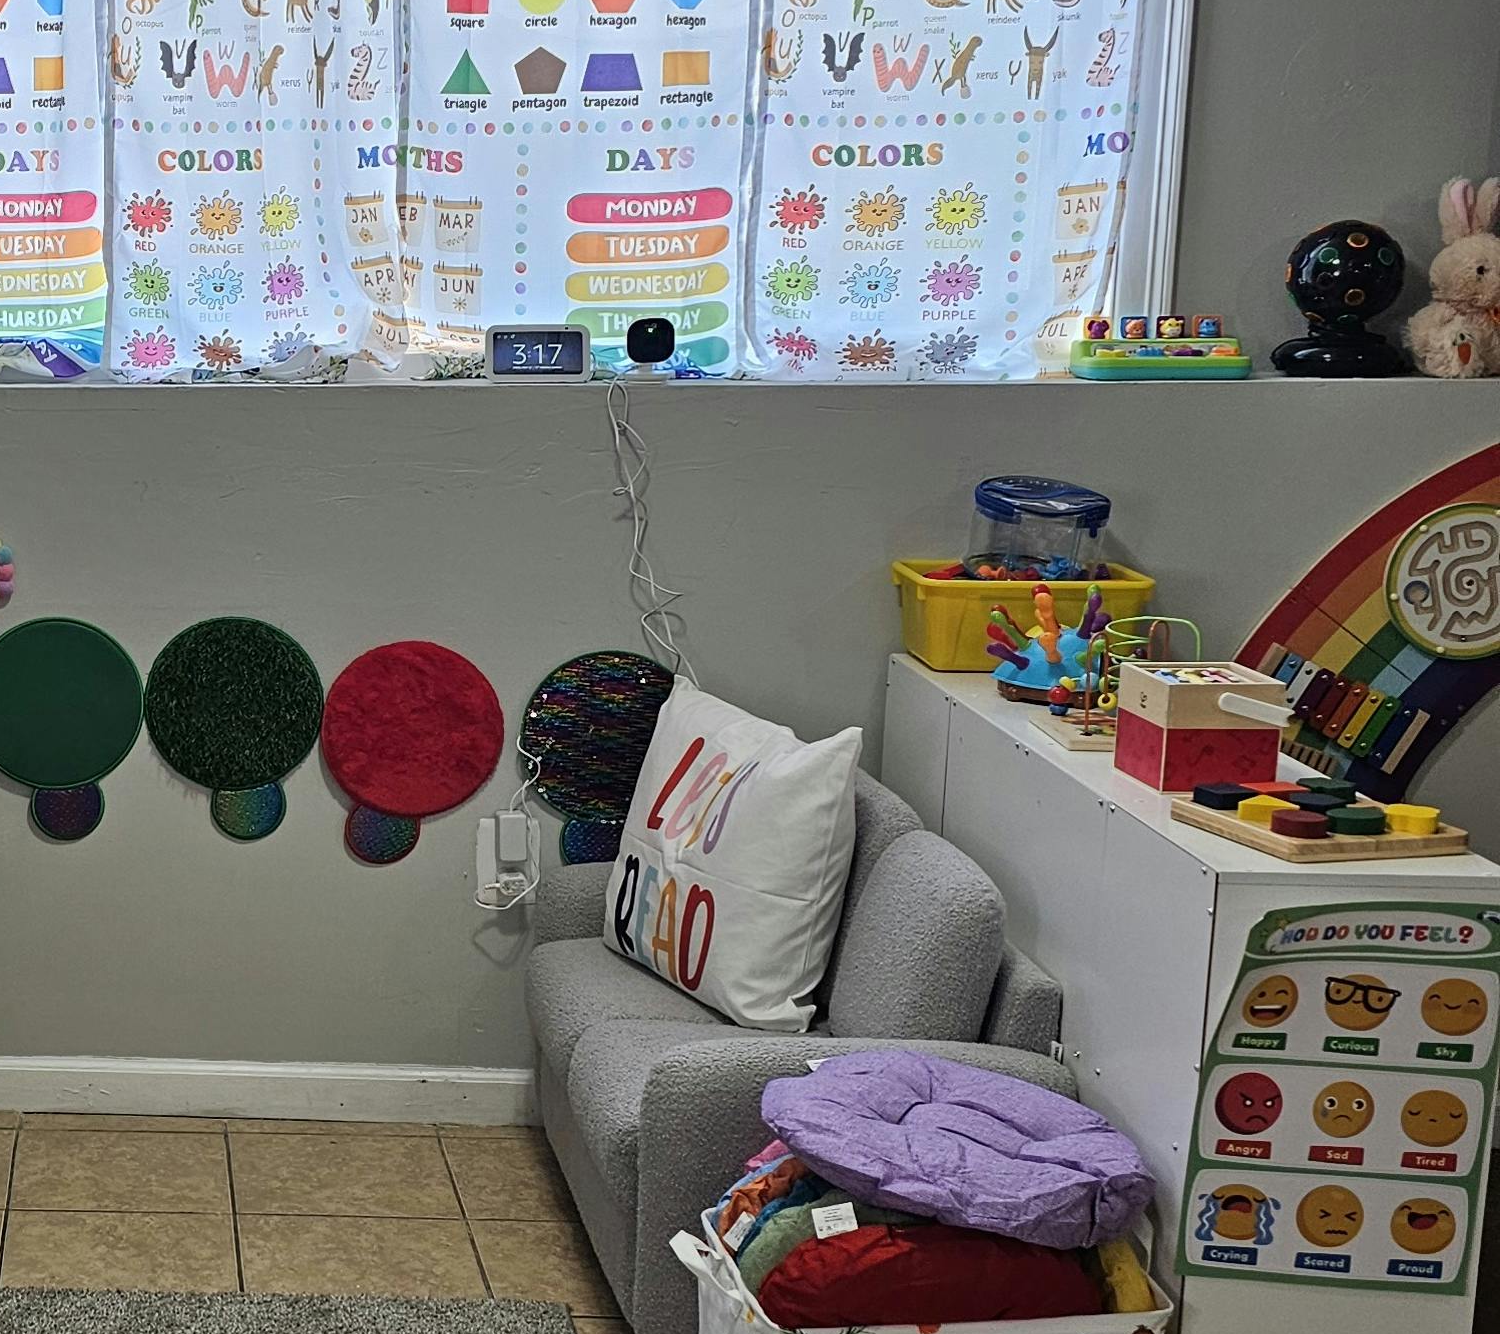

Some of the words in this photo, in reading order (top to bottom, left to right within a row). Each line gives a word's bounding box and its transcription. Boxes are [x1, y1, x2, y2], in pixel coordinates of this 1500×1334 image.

[449, 17, 485, 30] square
[525, 15, 558, 28] circle
[589, 14, 638, 29] hexagon
[666, 14, 706, 30] hexagon
[444, 96, 488, 112] triangle
[512, 97, 568, 113] pentagon
[583, 95, 640, 111] trapezoid
[660, 90, 714, 106] rectangle
[157, 149, 264, 172] COLORS
[606, 145, 696, 172] DAYS
[812, 142, 944, 167] COLORS
[605, 195, 698, 220] MONDAY
[1062, 196, 1101, 215] JAN
[351, 207, 378, 224] JAN
[439, 213, 474, 229] MAR
[133, 240, 157, 253] RED
[188, 243, 245, 255] ORANGE
[606, 233, 700, 258] TUESDAY
[781, 237, 807, 249] RED
[842, 239, 905, 252] ORANGE
[924, 236, 984, 250] YELLOW
[363, 271, 395, 289] APR
[440, 277, 475, 295] JUN
[588, 269, 709, 295] WEDNESDAY
[128, 306, 170, 319] GREEN
[265, 306, 310, 321] PURPLE
[770, 305, 812, 321] GREEN
[850, 310, 885, 322] BLUE
[921, 309, 977, 321] PURPLE
[1037, 322, 1069, 339] JUL
[512, 343, 564, 365] 3:17
[613, 853, 715, 993] READ
[1321, 925, 1350, 941] DO
[1354, 924, 1395, 941] YOU
[1399, 925, 1474, 944] FEEL?
[1240, 1036, 1280, 1049] Happy
[1329, 1039, 1375, 1054] Curious
[1433, 1046, 1458, 1058] Shy
[1225, 1142, 1264, 1156] Angry
[1326, 1149, 1349, 1161] Sad
[1414, 1155, 1447, 1168] Tired
[1210, 1249, 1249, 1263] Crying
[1303, 1256, 1345, 1269] Scared
[1398, 1263, 1434, 1275] Proud
